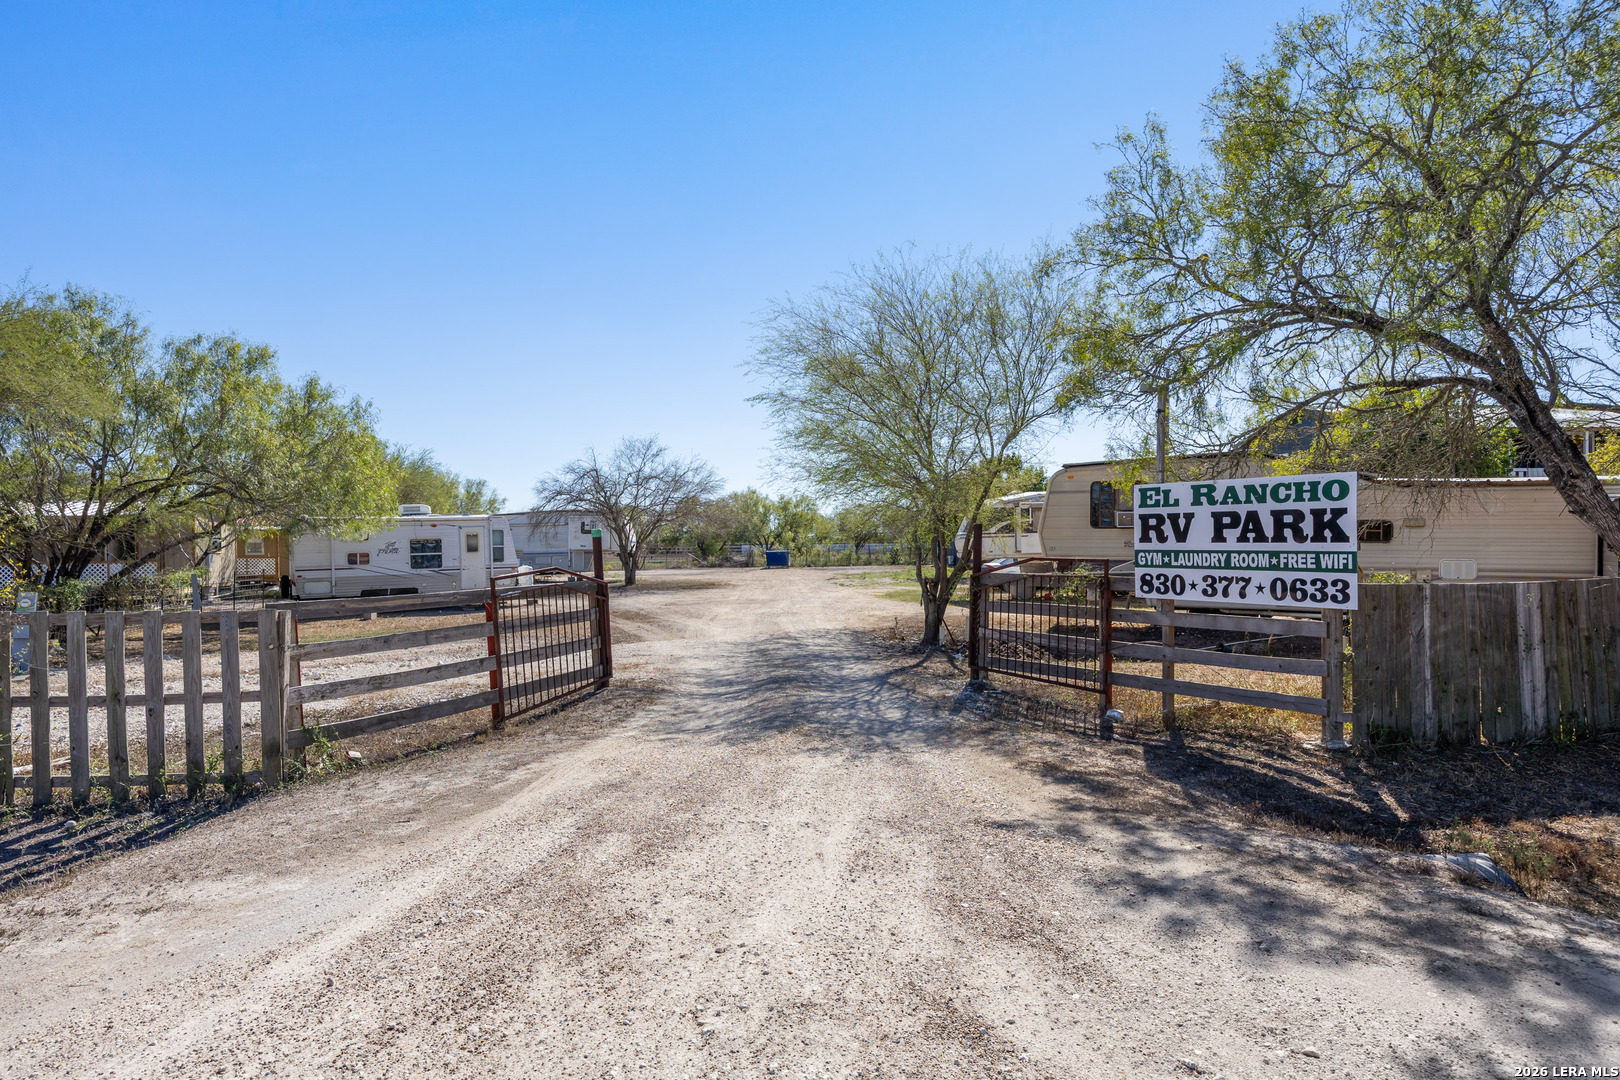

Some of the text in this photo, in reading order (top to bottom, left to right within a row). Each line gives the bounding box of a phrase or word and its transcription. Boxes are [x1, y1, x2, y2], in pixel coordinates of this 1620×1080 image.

[1138, 479, 1350, 508] EL RANCHO
[1138, 507, 1350, 544] RV PARK
[1137, 552, 1353, 570] GYM LAUNDRY ROOM FREE WIFI
[1139, 573, 1351, 604] 830 377 0633
